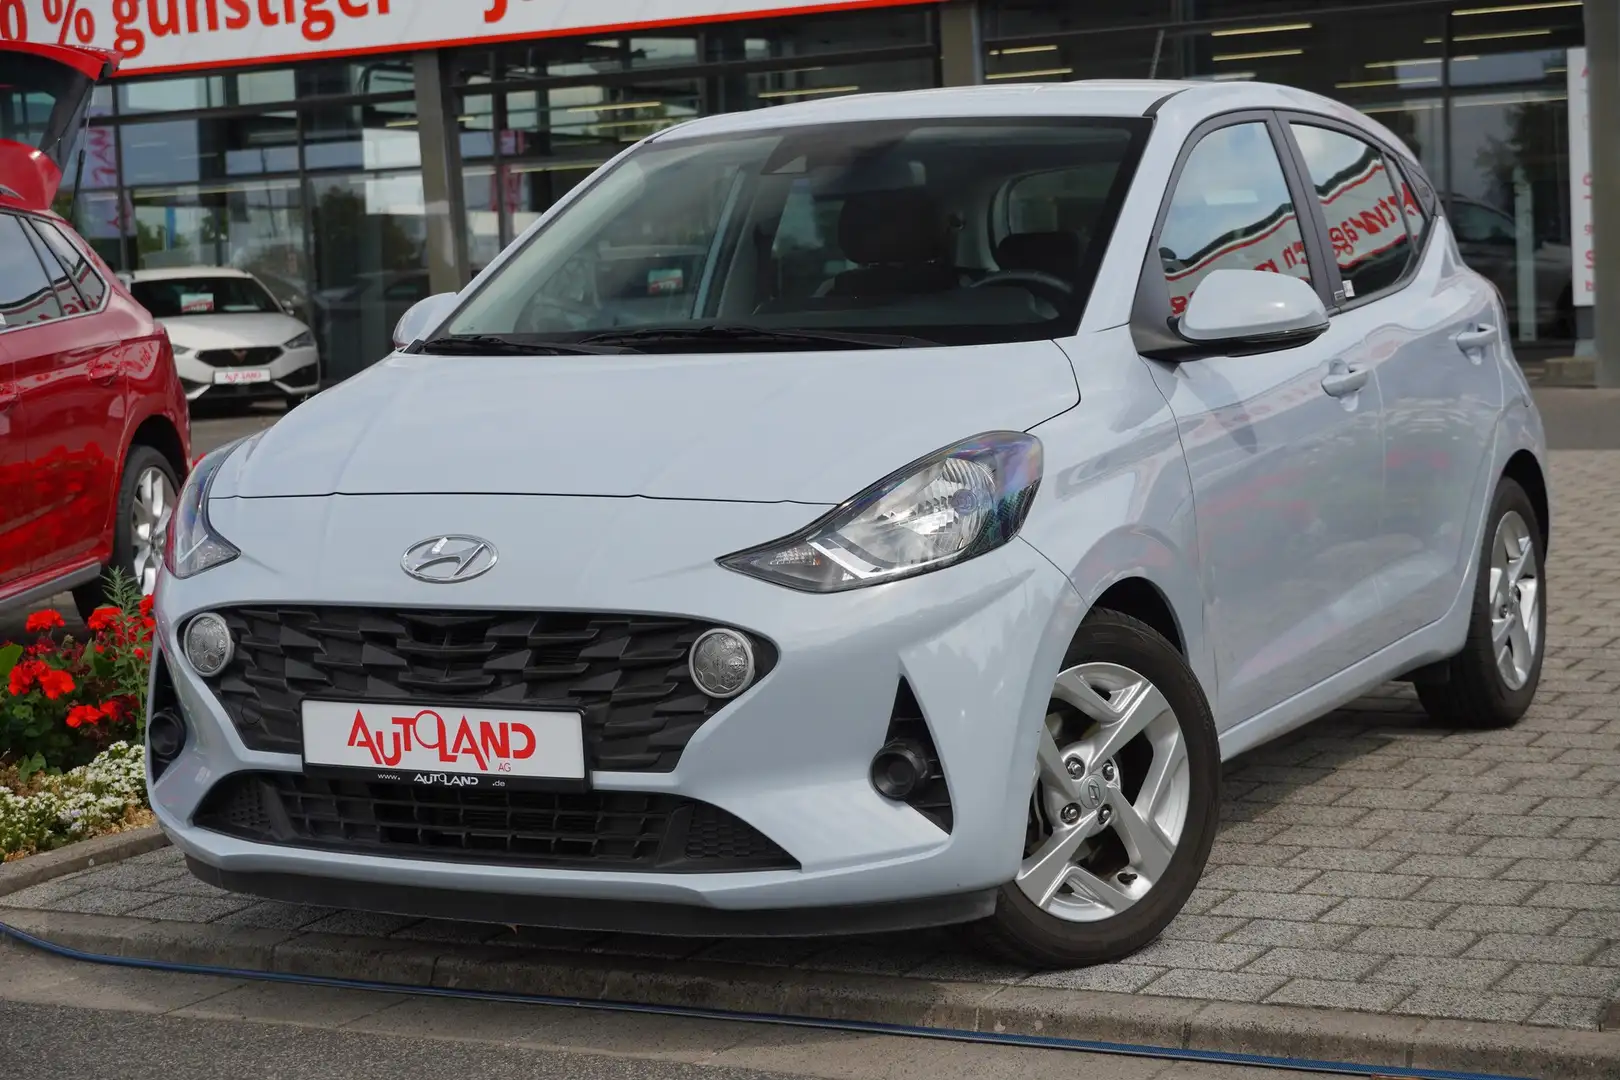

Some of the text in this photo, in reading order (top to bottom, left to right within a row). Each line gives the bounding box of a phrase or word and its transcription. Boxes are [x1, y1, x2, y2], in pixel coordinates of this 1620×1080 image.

[43, 0, 95, 44] %
[348, 709, 537, 771] AUTOLAND
[377, 772, 506, 787] www. AUTOLAND .de
[498, 762, 512, 772] AG
